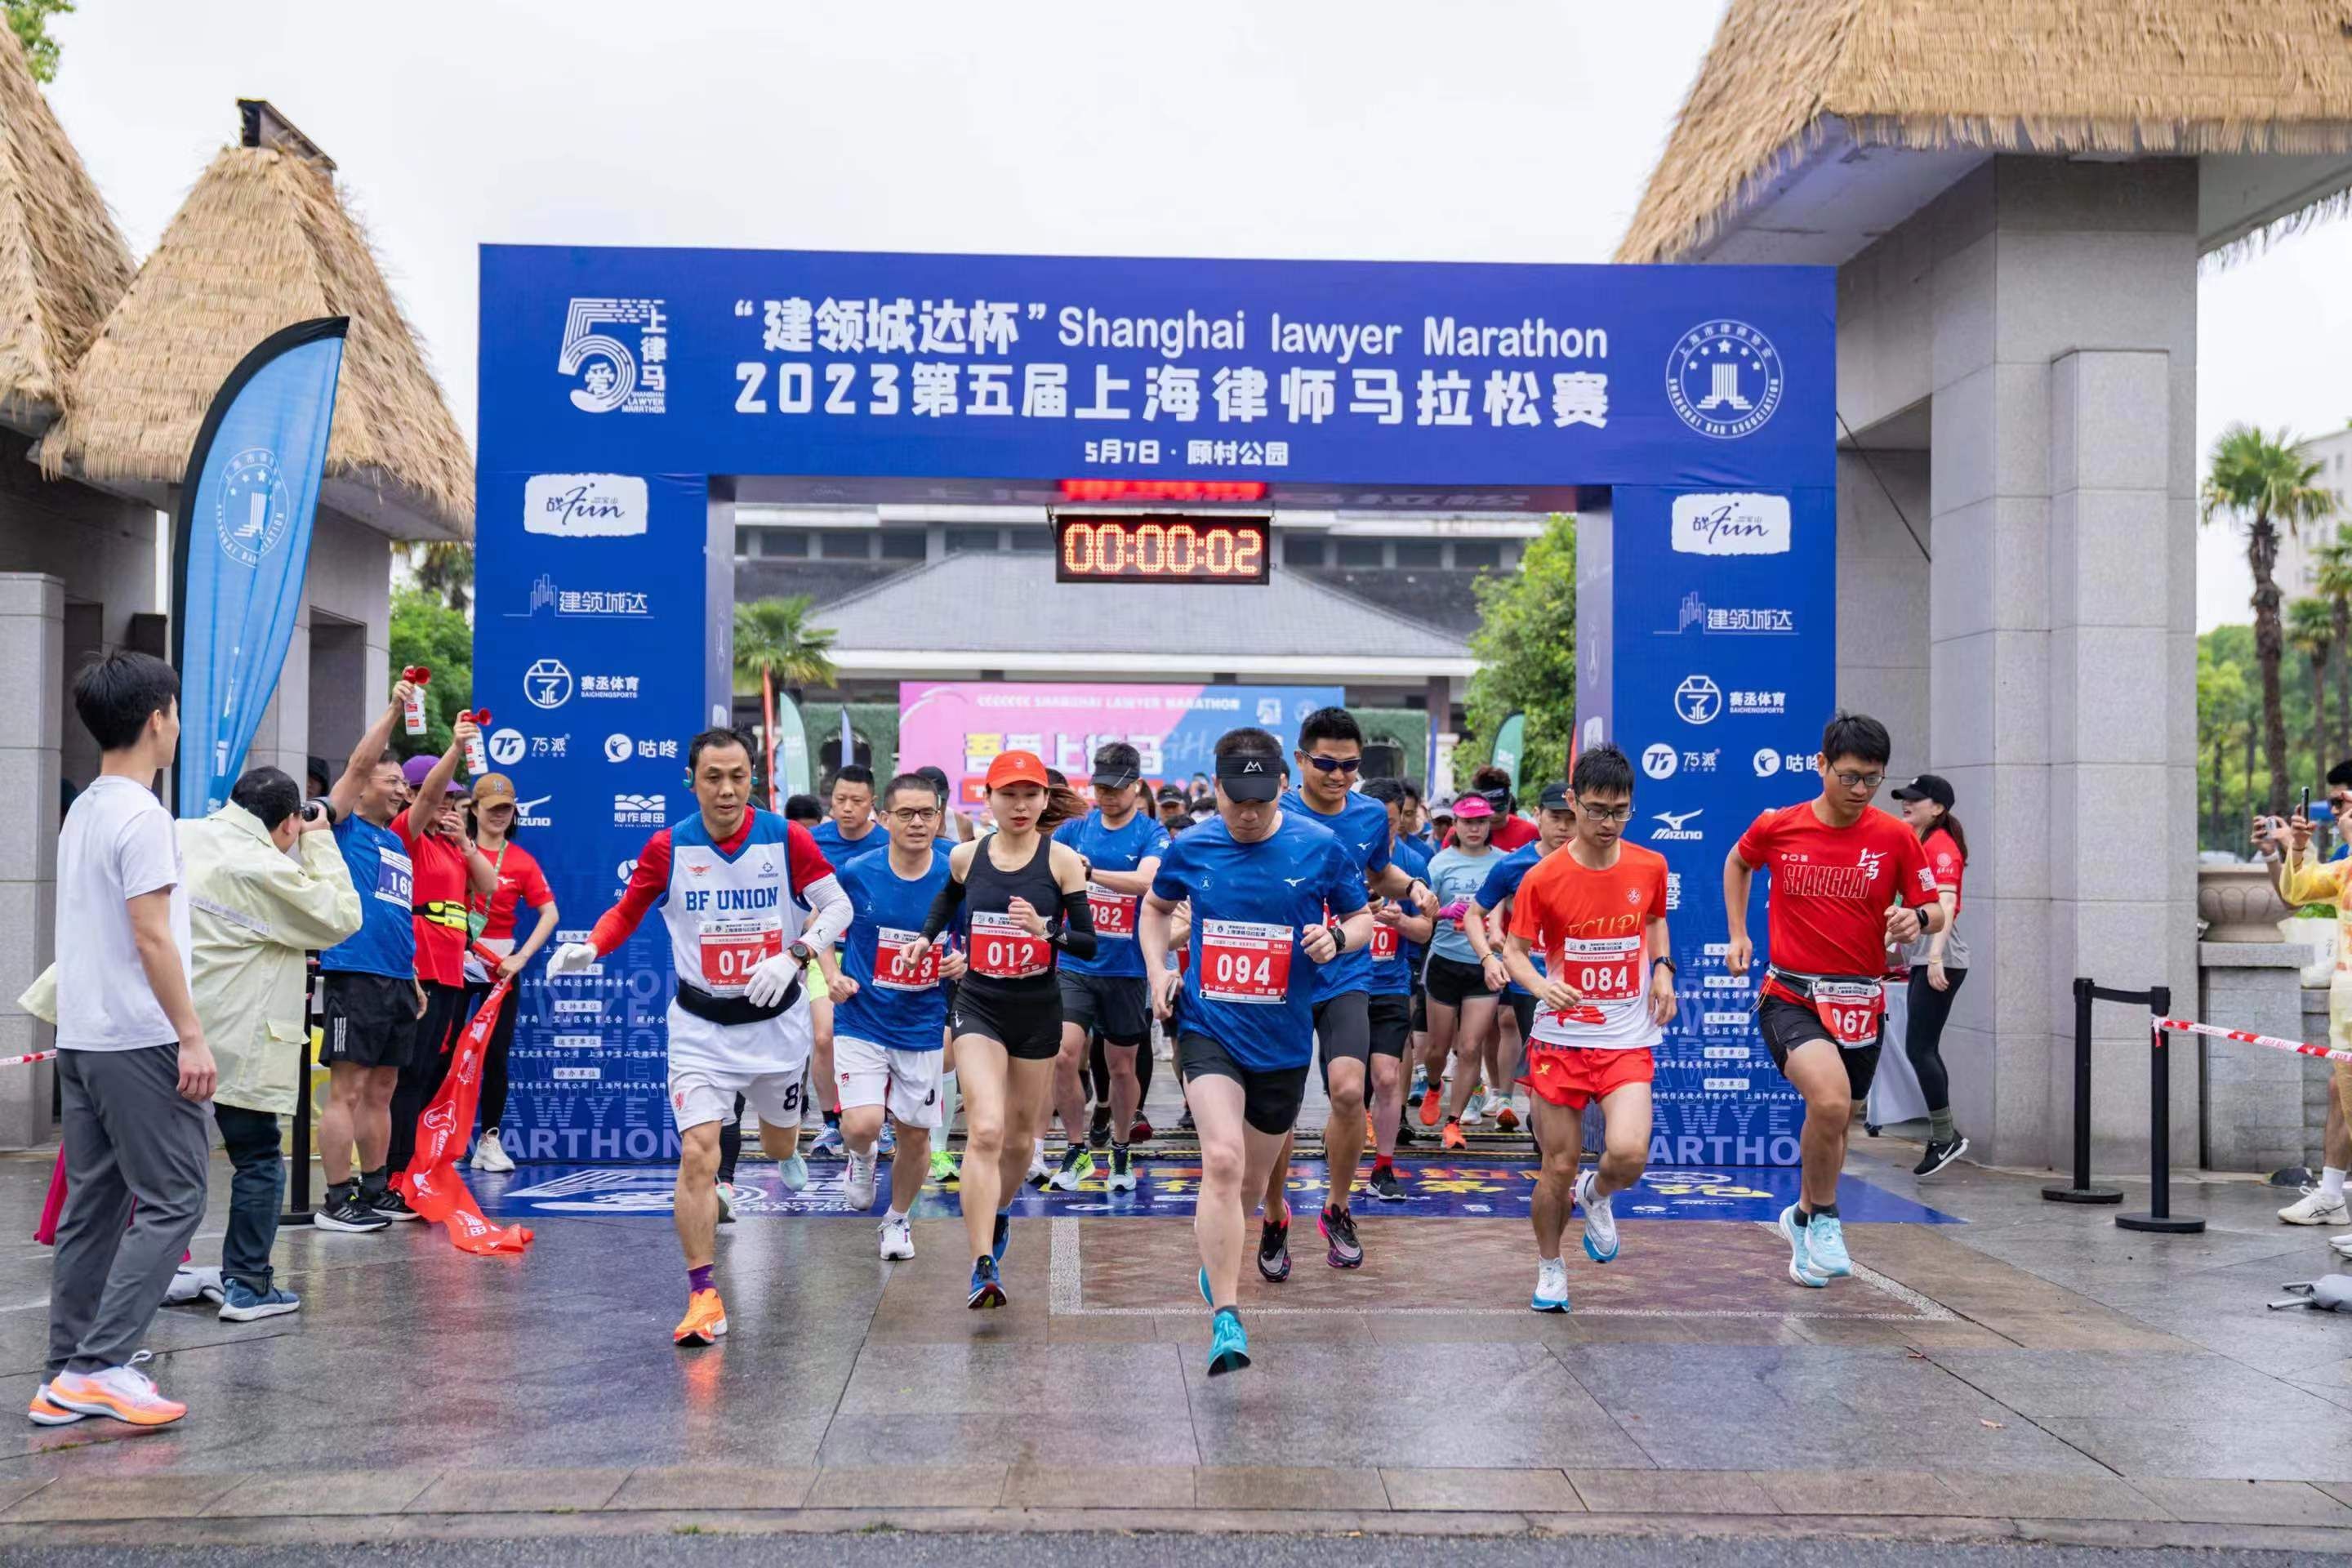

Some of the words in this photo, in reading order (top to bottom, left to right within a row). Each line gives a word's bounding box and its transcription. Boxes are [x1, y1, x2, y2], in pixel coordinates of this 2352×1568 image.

[1058, 305, 1245, 359] Shanghai
[1271, 312, 1402, 364] lawyer
[1423, 316, 1609, 359] Marathon
[621, 405, 666, 413] MARATHON
[627, 398, 664, 406] LAWYER
[1063, 523, 1263, 575] 00:00:02
[559, 591, 648, 613] 建领城达
[1707, 608, 1793, 630] 建领城达
[638, 739, 679, 759] 咕咚
[515, 817, 551, 826] IZUNO
[1783, 863, 1871, 899] SHANGHAI
[685, 890, 710, 911] BF
[716, 886, 778, 911] UNION
[891, 955, 933, 978] 03
[987, 942, 1034, 967] 012
[1217, 953, 1271, 986] 094
[1581, 965, 1628, 991] 084
